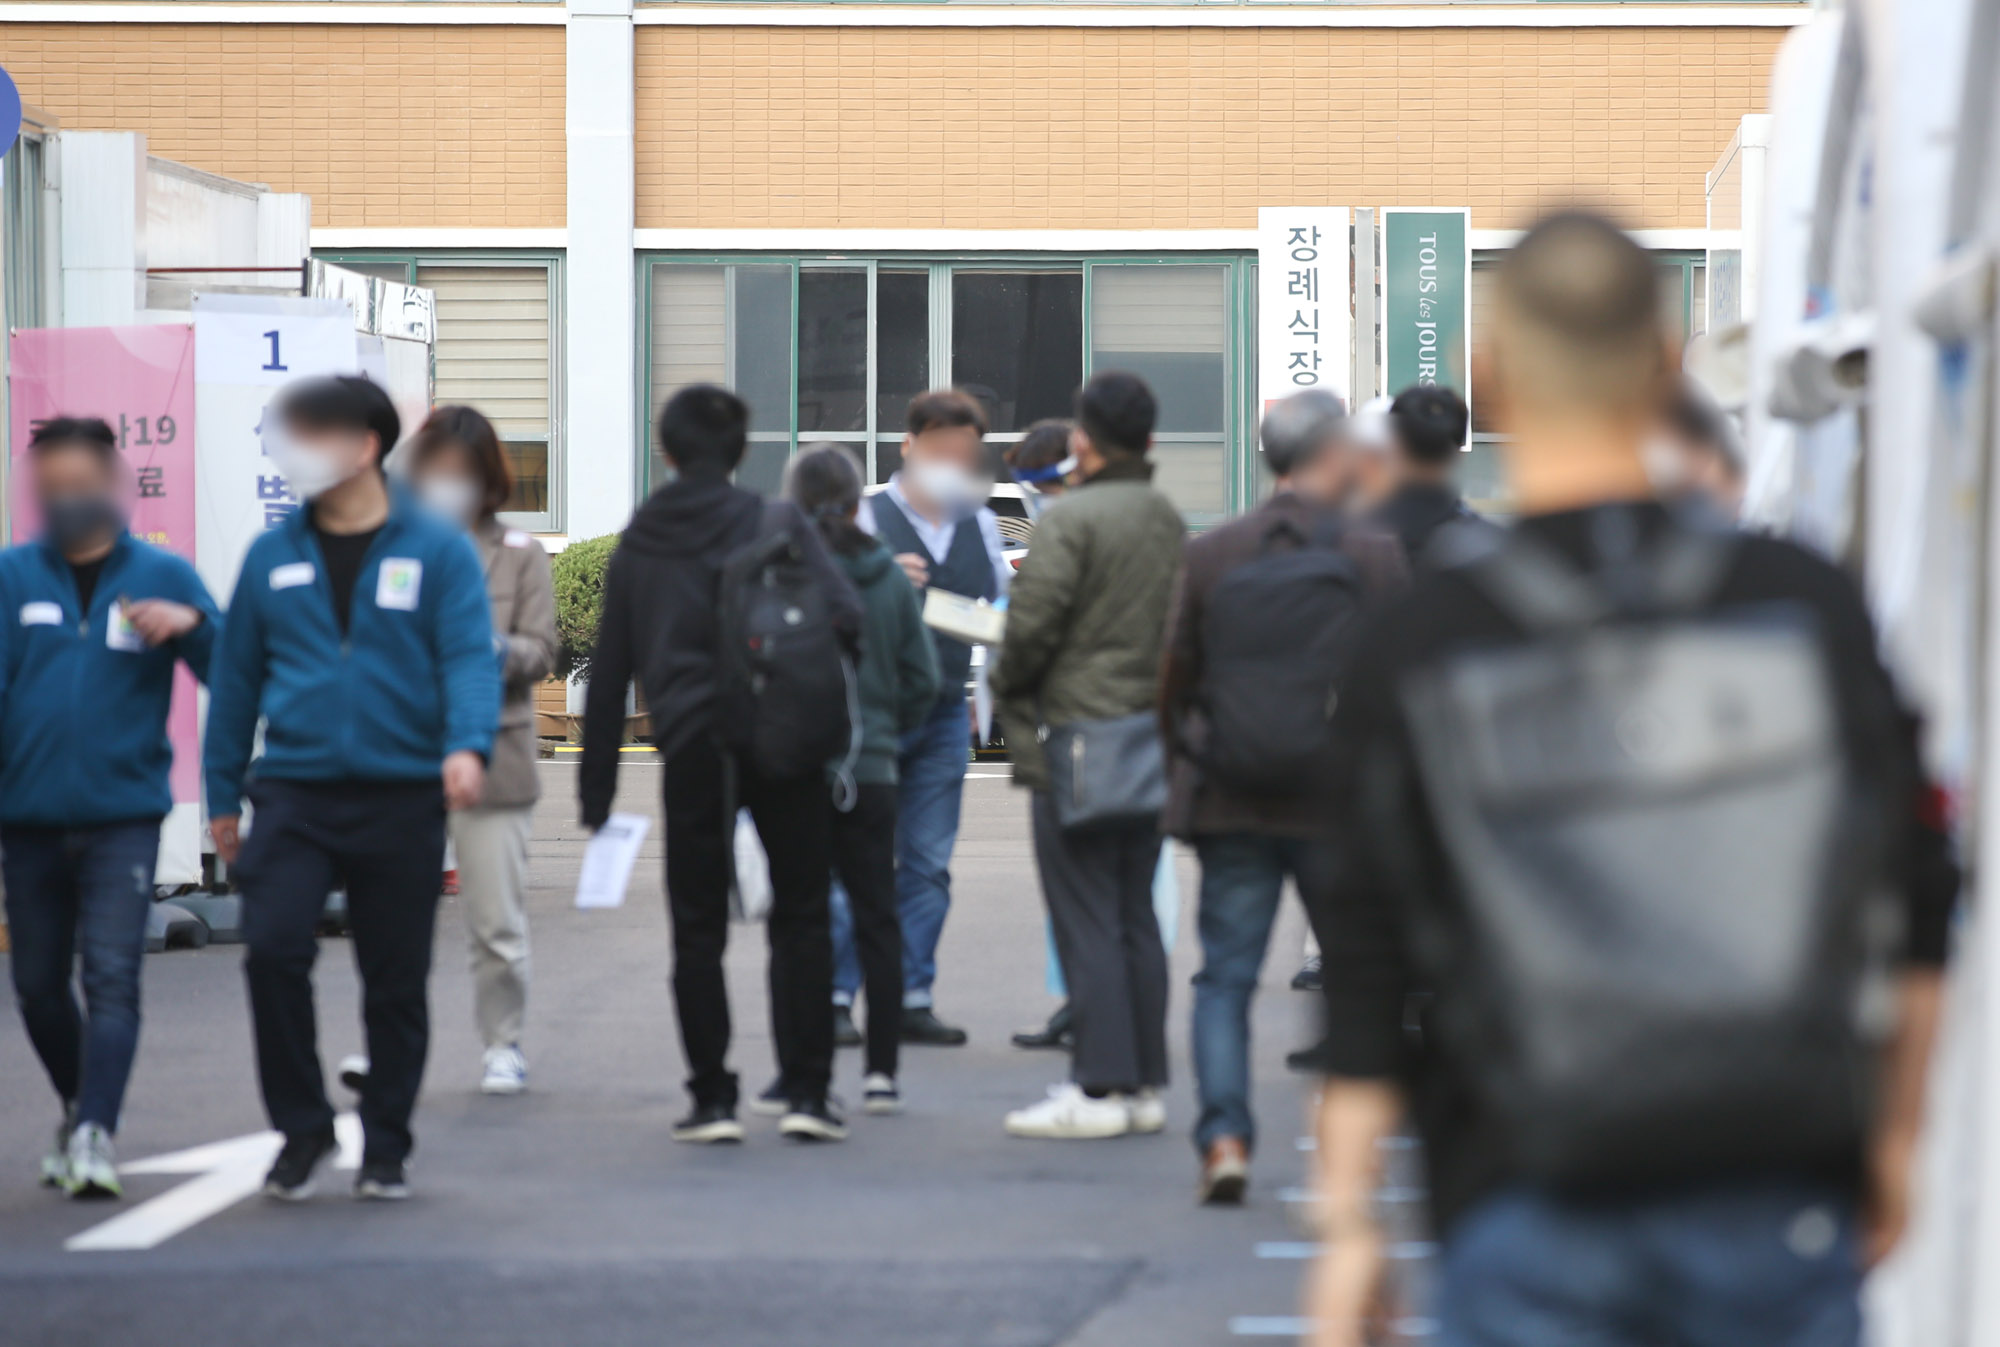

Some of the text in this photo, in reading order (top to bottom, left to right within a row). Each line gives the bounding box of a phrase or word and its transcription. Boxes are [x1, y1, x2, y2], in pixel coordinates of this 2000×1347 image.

[1418, 231, 1437, 294] TOUS
[1287, 225, 1322, 386] 장례식장
[1418, 297, 1437, 318] les
[262, 330, 288, 371] 1
